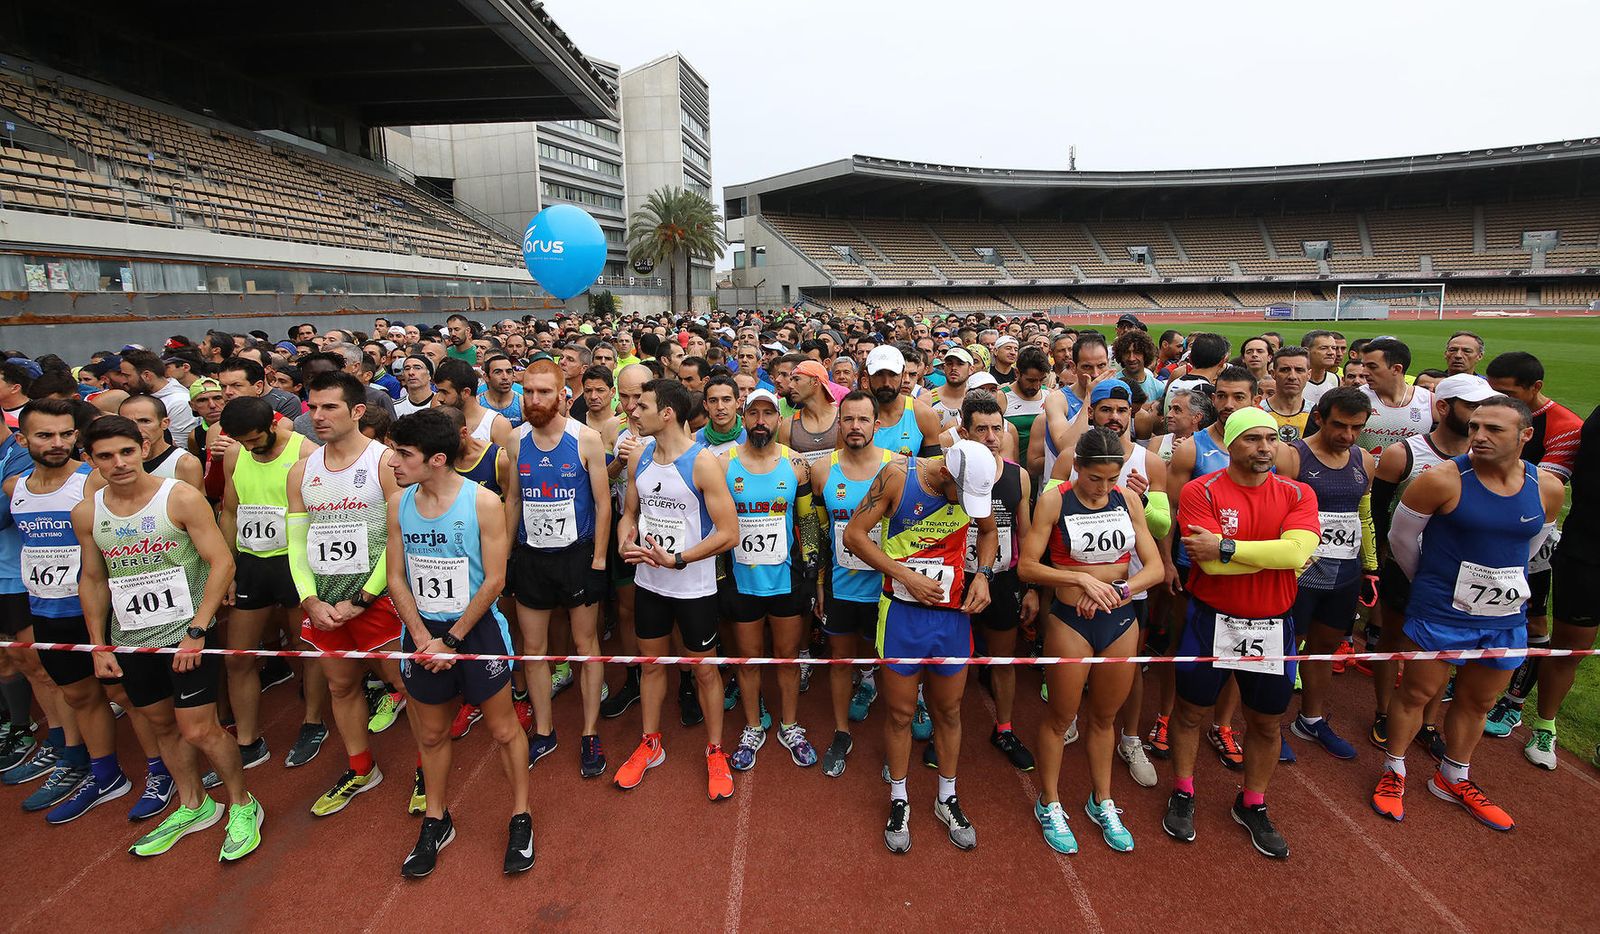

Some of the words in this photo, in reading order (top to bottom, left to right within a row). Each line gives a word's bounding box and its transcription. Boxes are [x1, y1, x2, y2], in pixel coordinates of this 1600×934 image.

[307, 496, 369, 512] maratón
[647, 499, 687, 511] CUERVO
[749, 501, 770, 514] LOS
[19, 520, 73, 533] Beiman
[242, 520, 276, 539] 616
[404, 529, 448, 547] nerja
[741, 533, 778, 553] 637
[1082, 529, 1126, 553] 260
[1321, 528, 1356, 548] 584
[318, 540, 357, 562] 159
[111, 555, 163, 570] JEREZ
[30, 565, 70, 586] 467
[416, 576, 455, 599] 131
[1469, 583, 1520, 607] 729
[125, 588, 177, 615] 401
[1233, 638, 1264, 657] 45
